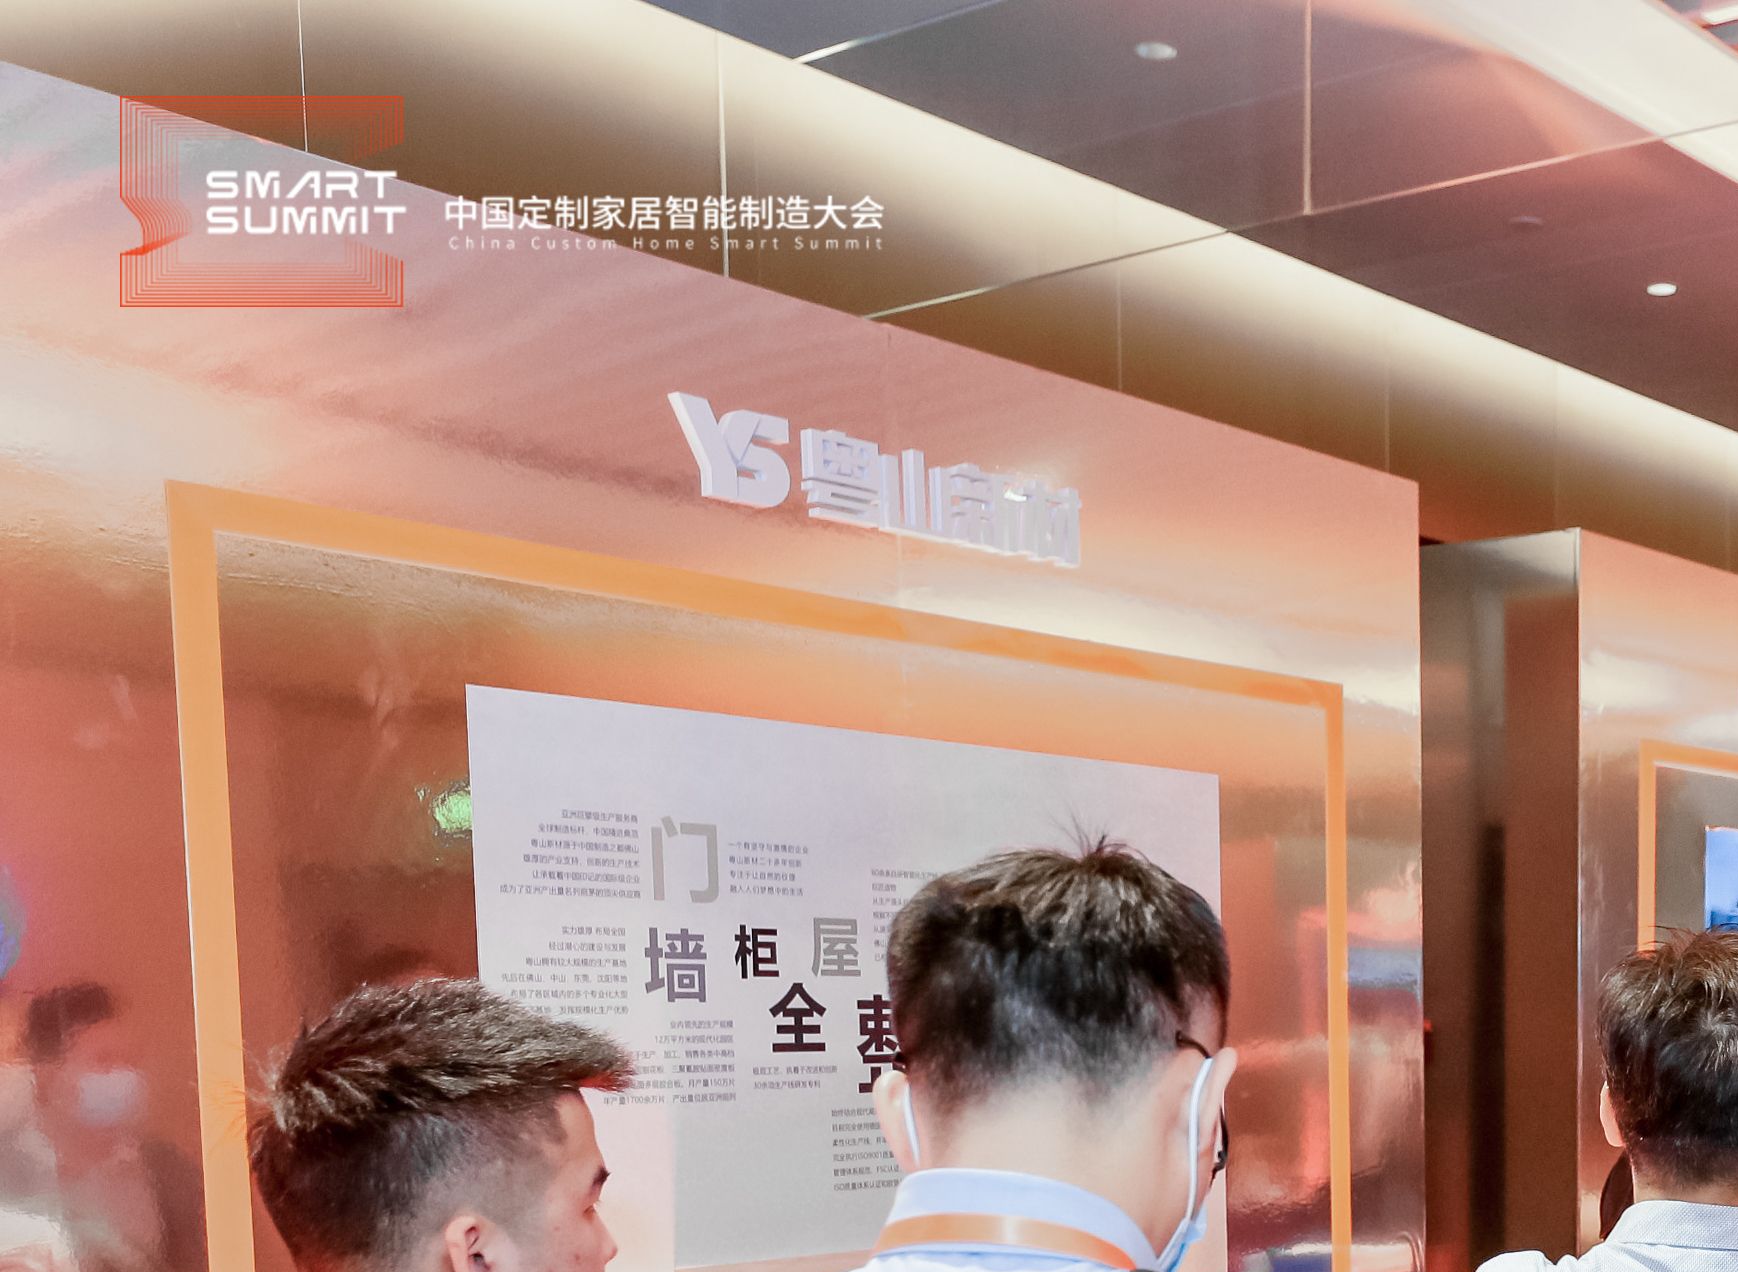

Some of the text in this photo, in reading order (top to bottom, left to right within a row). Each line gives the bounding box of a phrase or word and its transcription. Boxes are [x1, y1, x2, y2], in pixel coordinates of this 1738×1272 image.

[650, 815, 720, 904] 门
[644, 916, 862, 1003] 墙 柜 屋
[769, 982, 827, 1053] 全
